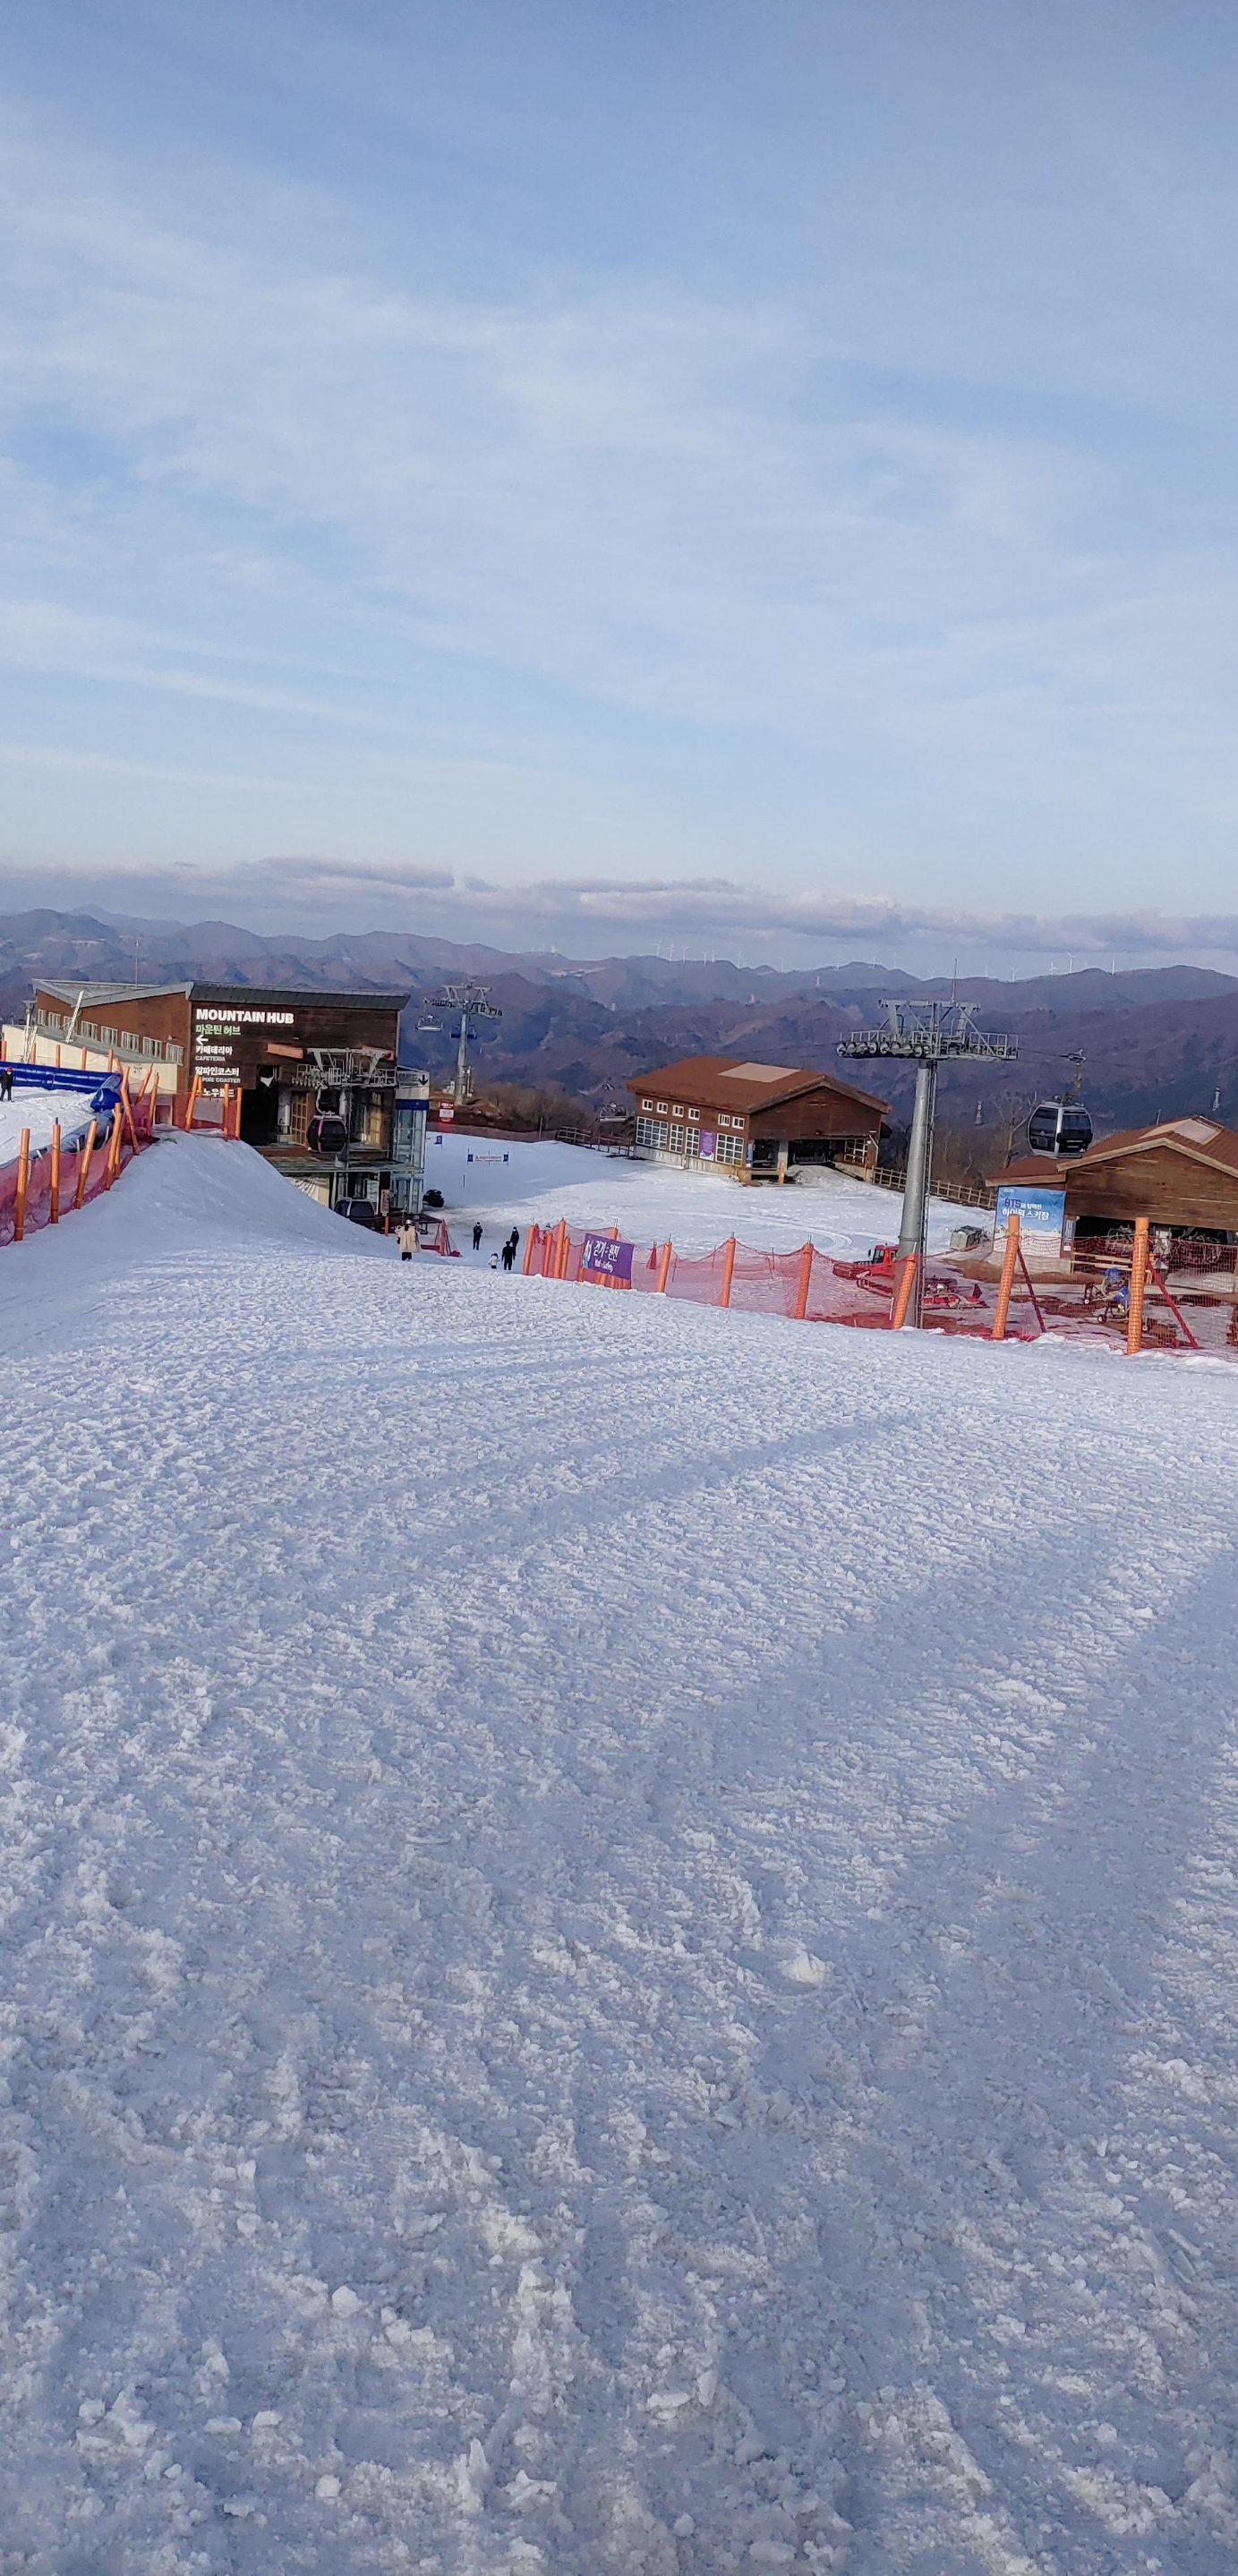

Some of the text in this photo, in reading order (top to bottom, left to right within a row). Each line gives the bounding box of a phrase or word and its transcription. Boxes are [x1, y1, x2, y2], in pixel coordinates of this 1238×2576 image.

[196, 1009, 295, 1024] MOUNTAIN HUB
[195, 1024, 241, 1036] 마운틴 허브
[195, 1045, 233, 1055] 카페테리아
[195, 1066, 239, 1077] 알파인코스터
[1026, 1210, 1049, 1221] 스키장
